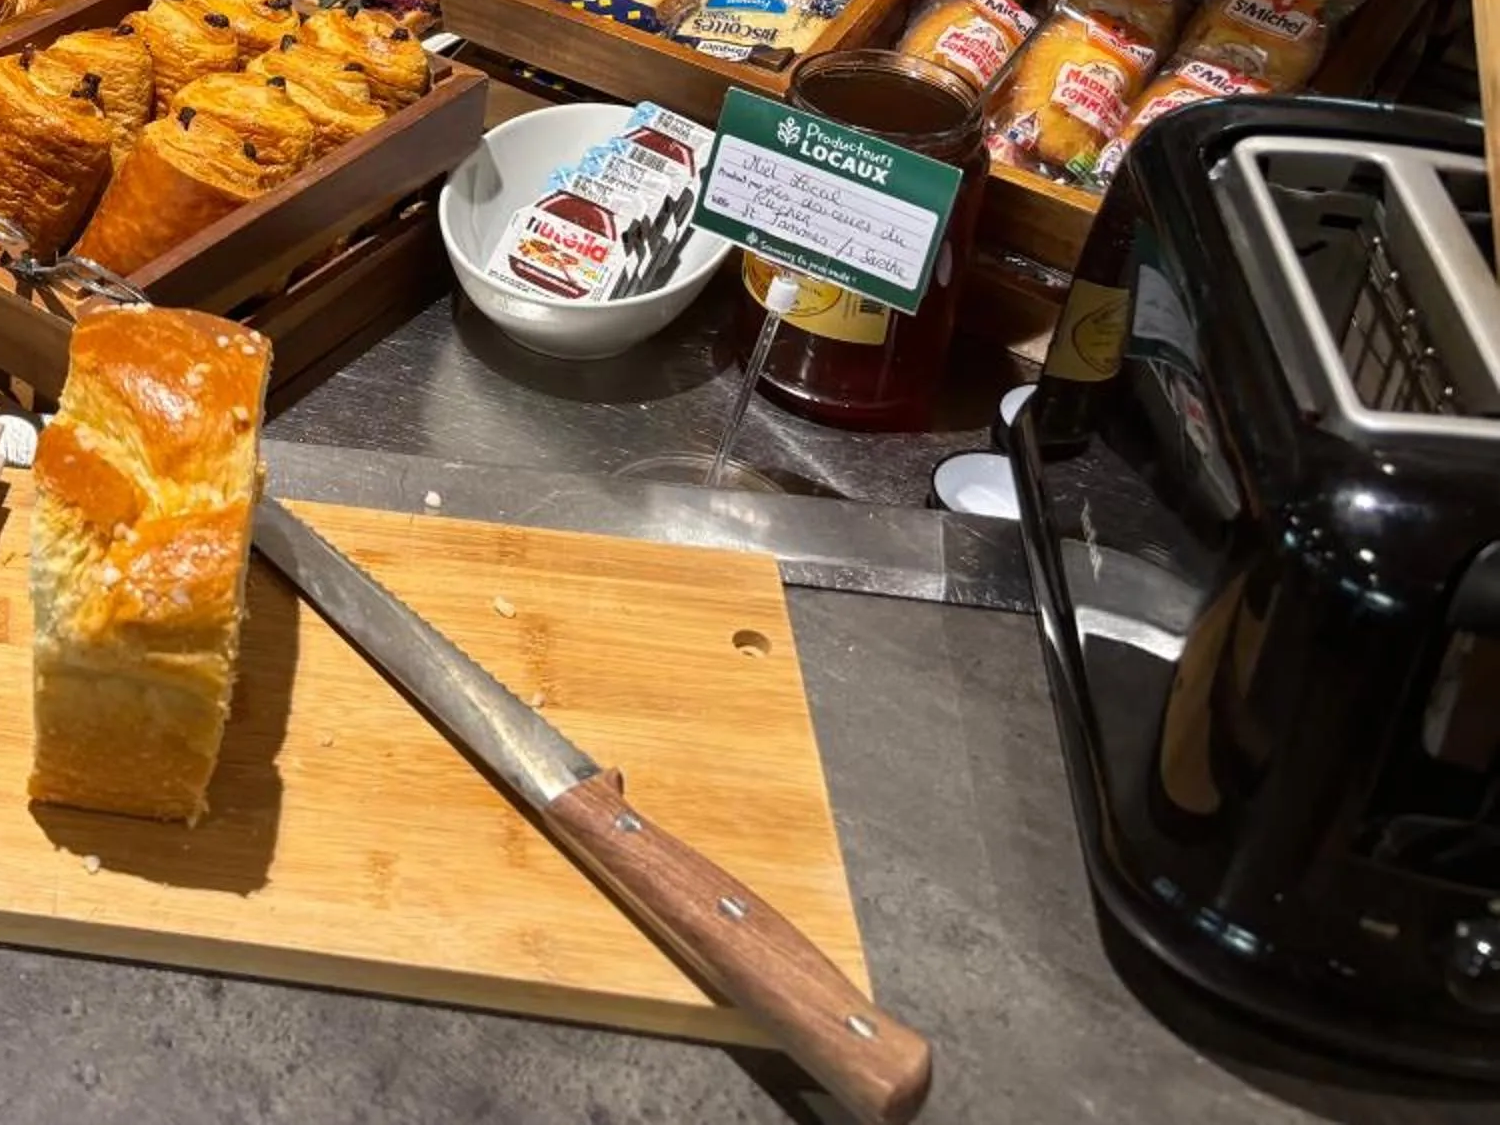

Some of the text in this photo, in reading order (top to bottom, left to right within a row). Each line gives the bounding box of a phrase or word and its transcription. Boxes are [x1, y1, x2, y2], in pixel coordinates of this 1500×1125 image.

[1243, 1, 1307, 34] Michel
[799, 140, 890, 186] LOCAUX
[805, 122, 895, 165] Producteurs
[526, 216, 610, 265] nutella
